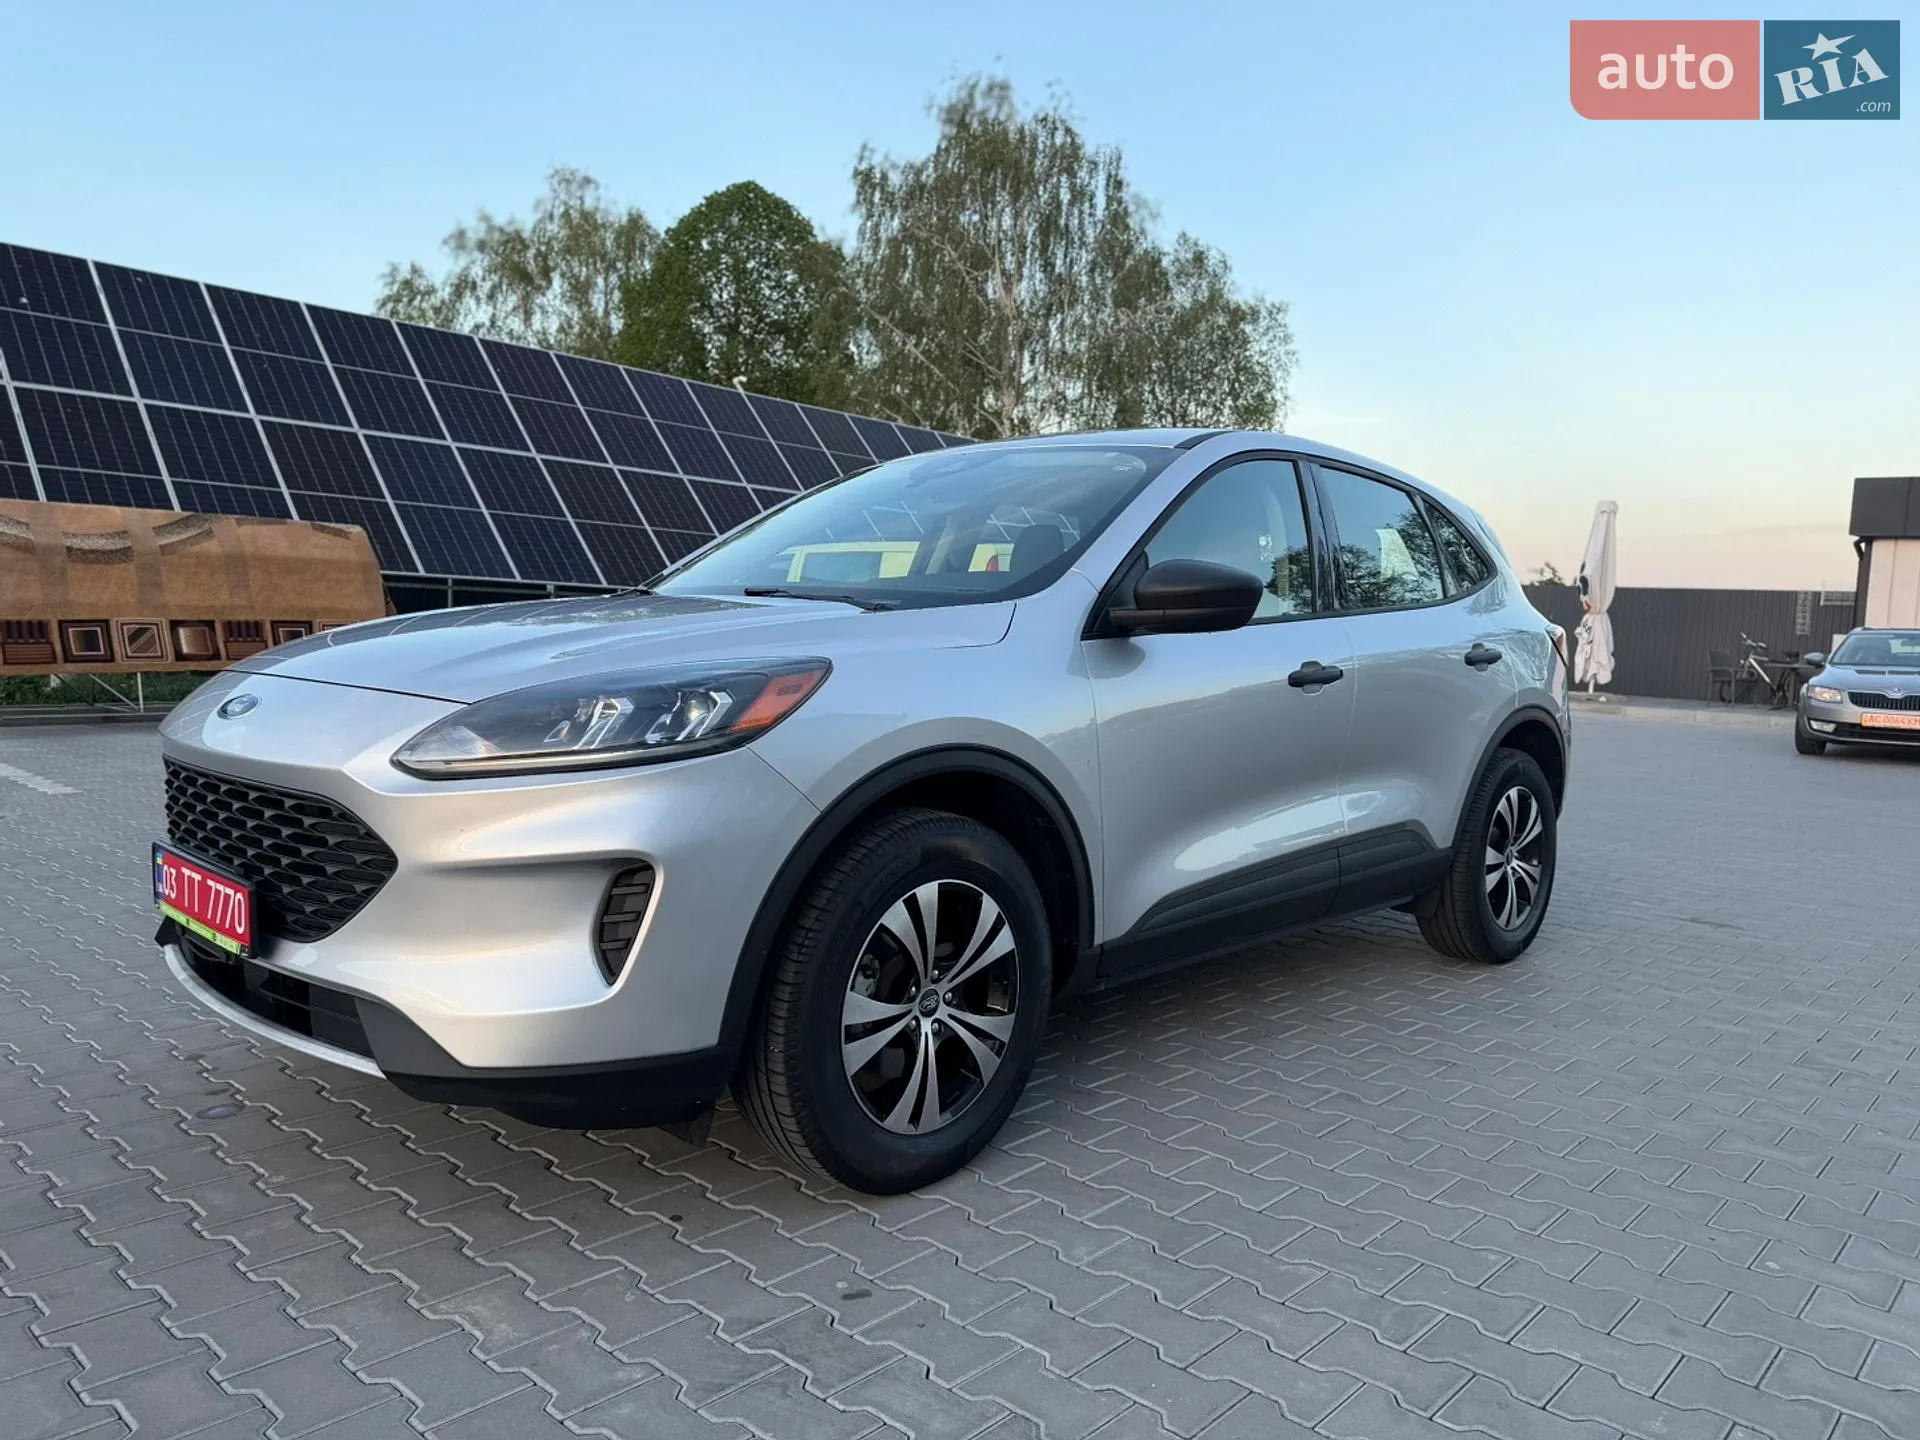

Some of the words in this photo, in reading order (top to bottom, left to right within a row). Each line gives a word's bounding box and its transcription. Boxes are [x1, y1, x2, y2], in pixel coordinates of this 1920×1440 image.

[163, 864, 176, 899] 03
[181, 866, 202, 913] TT
[207, 879, 245, 934] 7770
